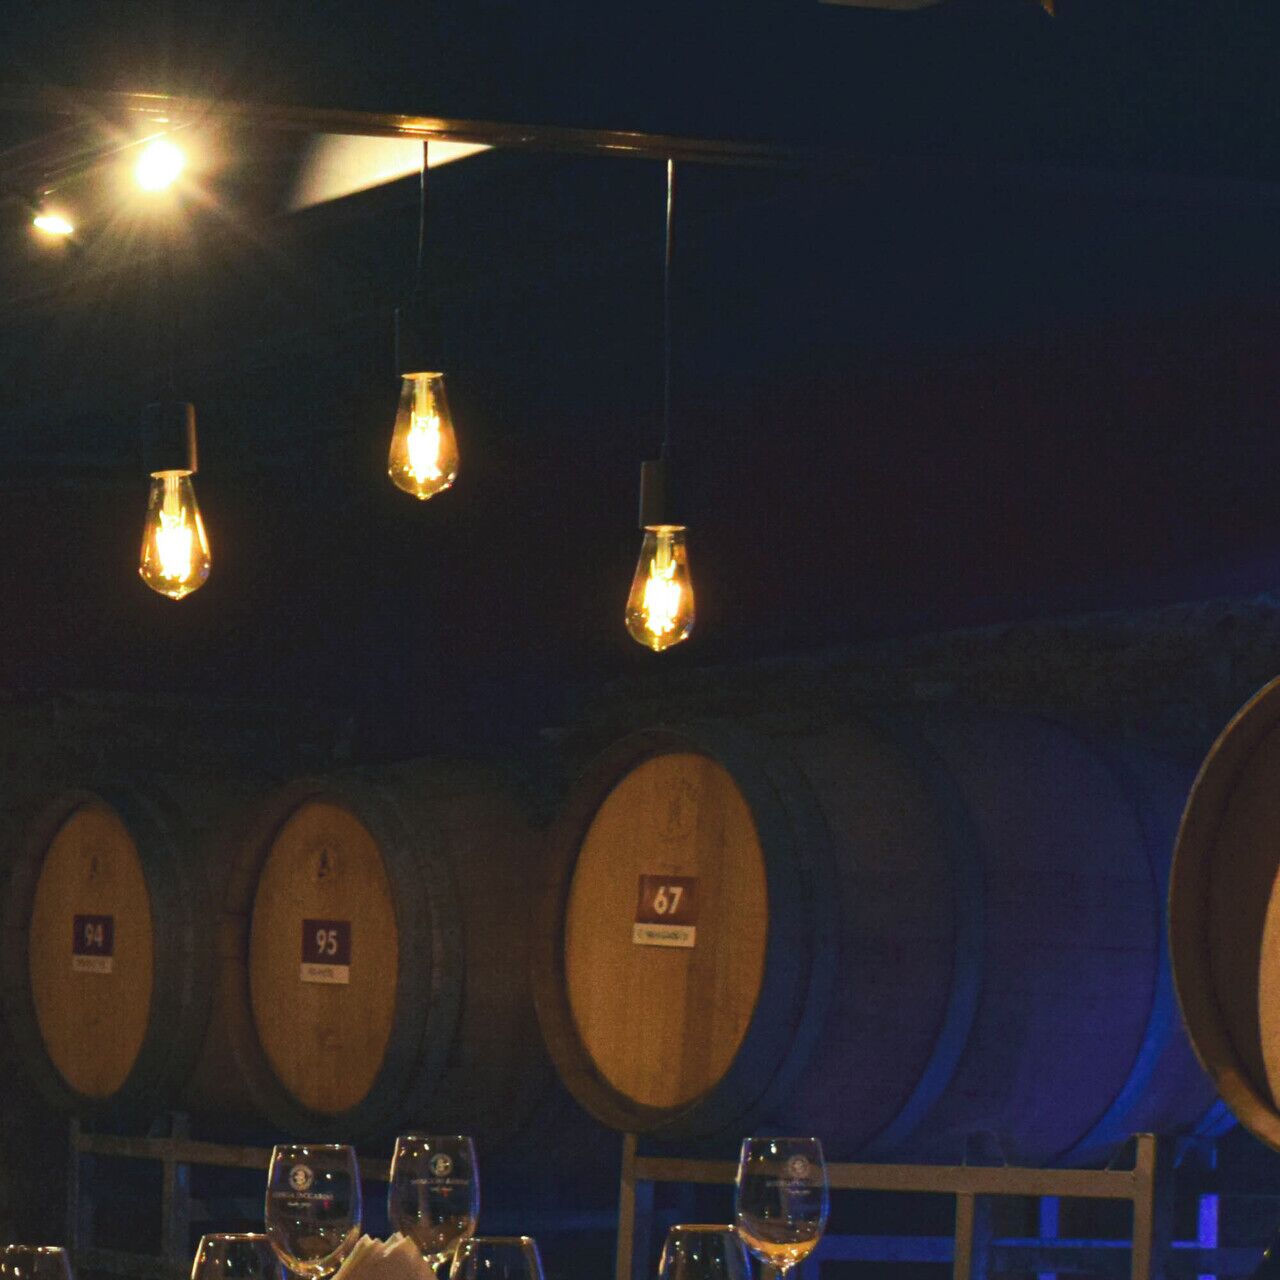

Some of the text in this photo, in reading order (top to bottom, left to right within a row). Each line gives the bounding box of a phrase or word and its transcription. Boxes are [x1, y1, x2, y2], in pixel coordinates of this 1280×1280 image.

[653, 885, 684, 915] 67
[84, 922, 105, 947] 94
[316, 929, 338, 955] 95
